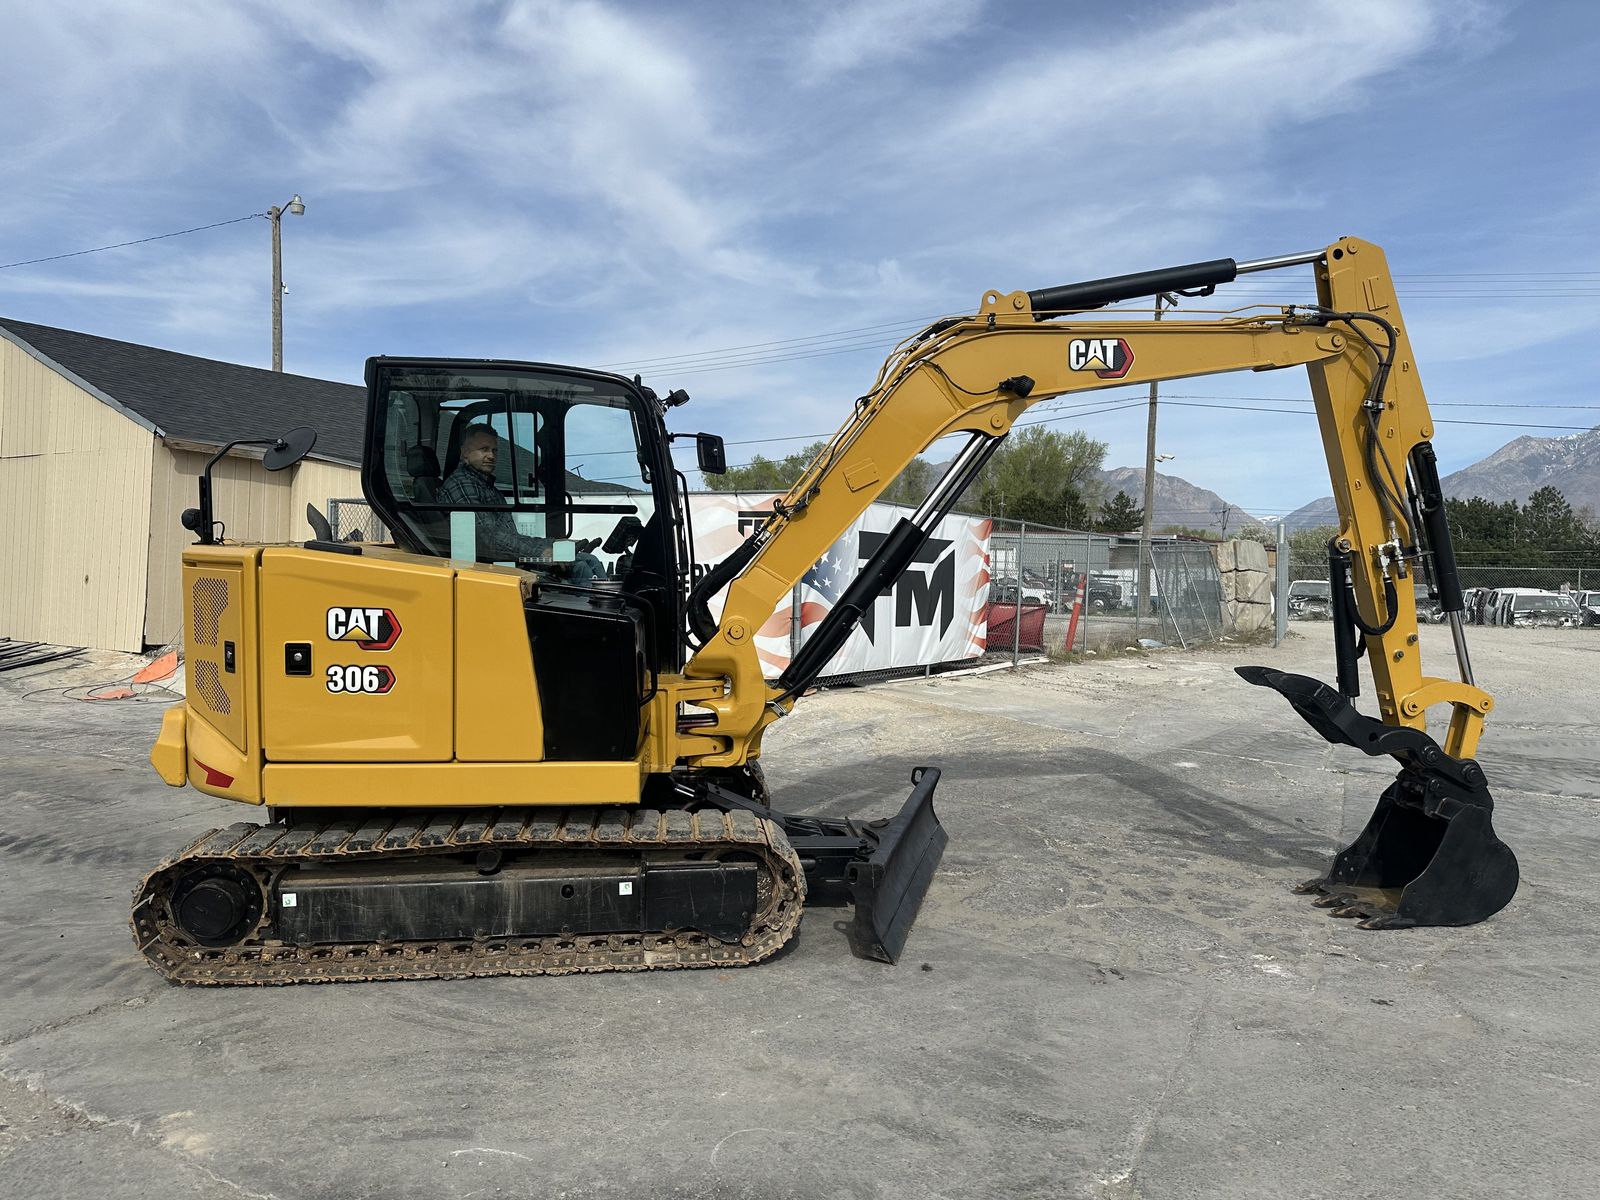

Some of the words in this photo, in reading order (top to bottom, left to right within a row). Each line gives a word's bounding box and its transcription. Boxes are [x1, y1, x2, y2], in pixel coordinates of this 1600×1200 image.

[1069, 339, 1118, 371] CAT
[327, 607, 384, 641] CAT
[327, 665, 380, 693] 306
